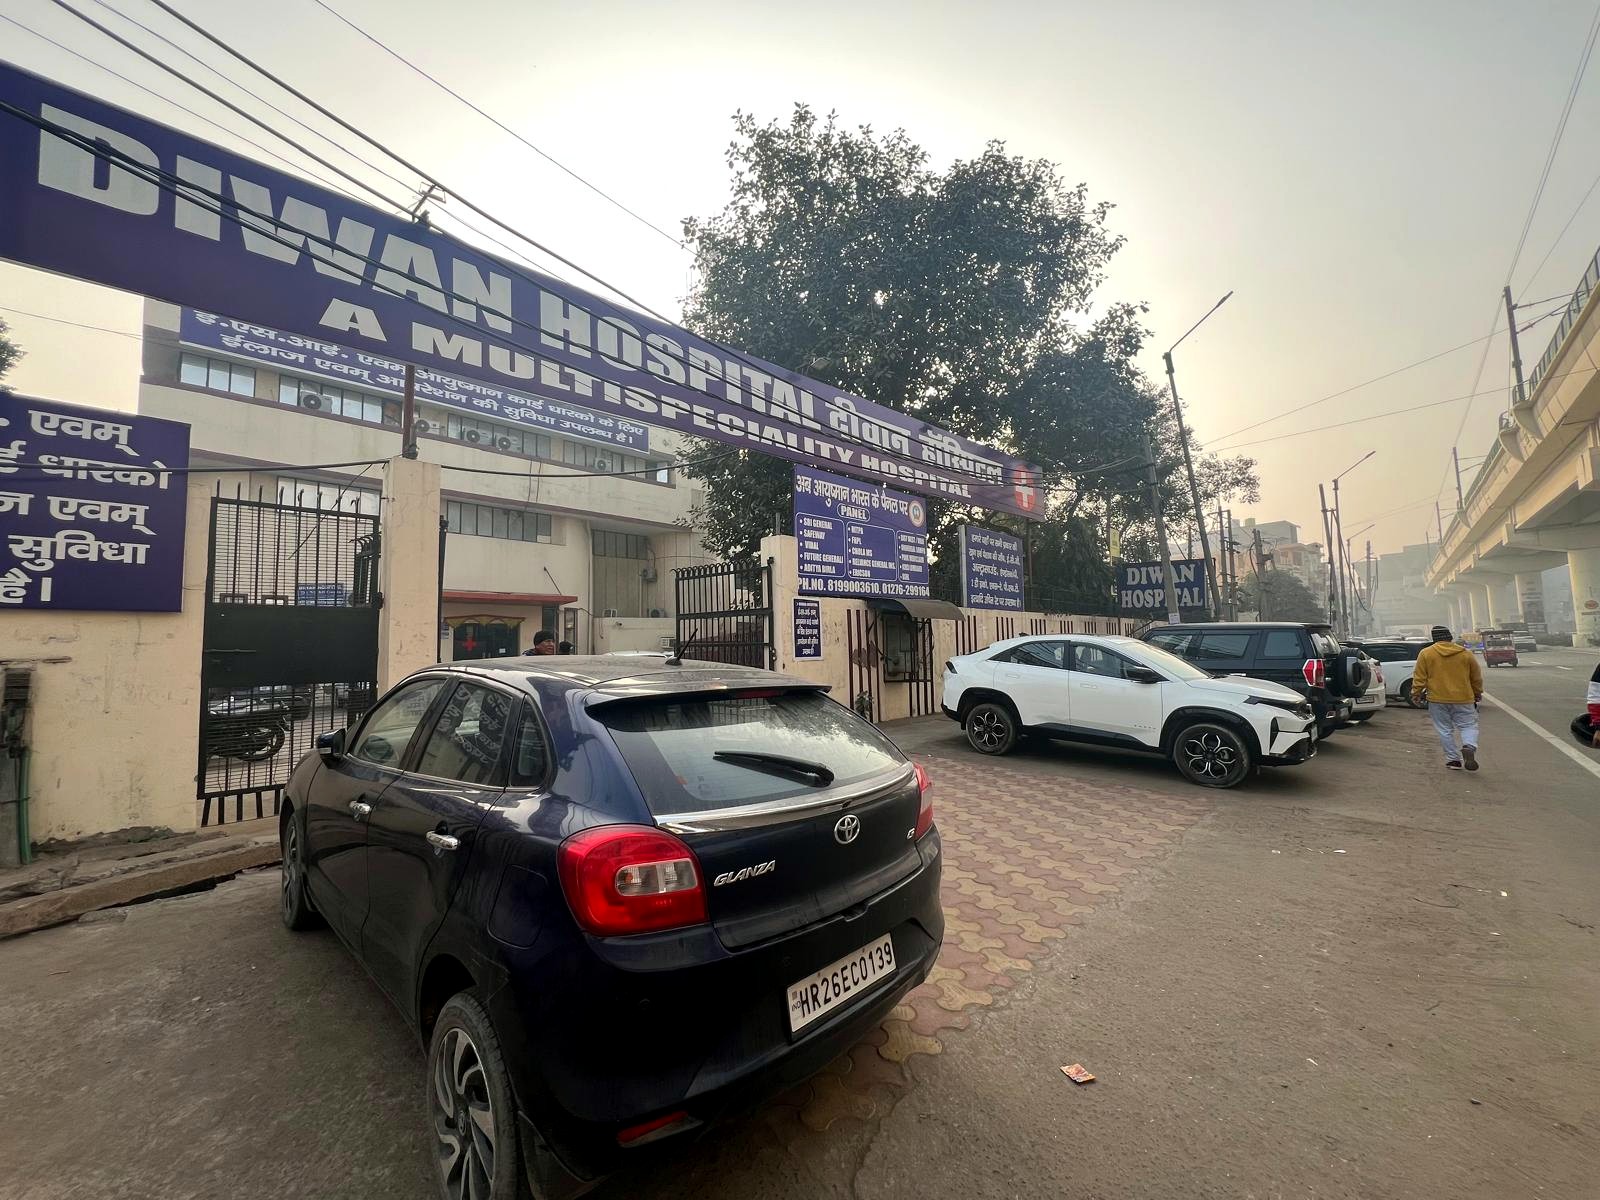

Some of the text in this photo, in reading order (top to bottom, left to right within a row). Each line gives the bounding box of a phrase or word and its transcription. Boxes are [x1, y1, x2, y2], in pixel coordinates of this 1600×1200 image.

[38, 103, 822, 431] DIWAN HOSPITAL
[313, 357, 375, 384] एवम्
[472, 393, 500, 411] की
[503, 404, 555, 426] सुविधा
[559, 419, 613, 438] उपलब्ध
[319, 298, 972, 499] A MULTISPECIALITY HOSPITAL
[415, 367, 503, 399] आयुष्मान
[507, 388, 546, 410] कार्ड
[598, 415, 615, 429] के
[617, 419, 645, 436] लिए
[28, 409, 140, 456] एवम्
[38, 460, 173, 490] धारको
[796, 475, 811, 494] अब
[814, 479, 850, 507] आयुष्मान
[851, 488, 870, 507] भारत
[871, 489, 880, 508] के
[900, 500, 909, 516] पर
[47, 495, 158, 536] एवम्
[841, 505, 867, 520] PANEL
[7, 529, 151, 572] सुविधा
[713, 860, 776, 887] GLANZA
[799, 942, 893, 1018] HR26EC0139
